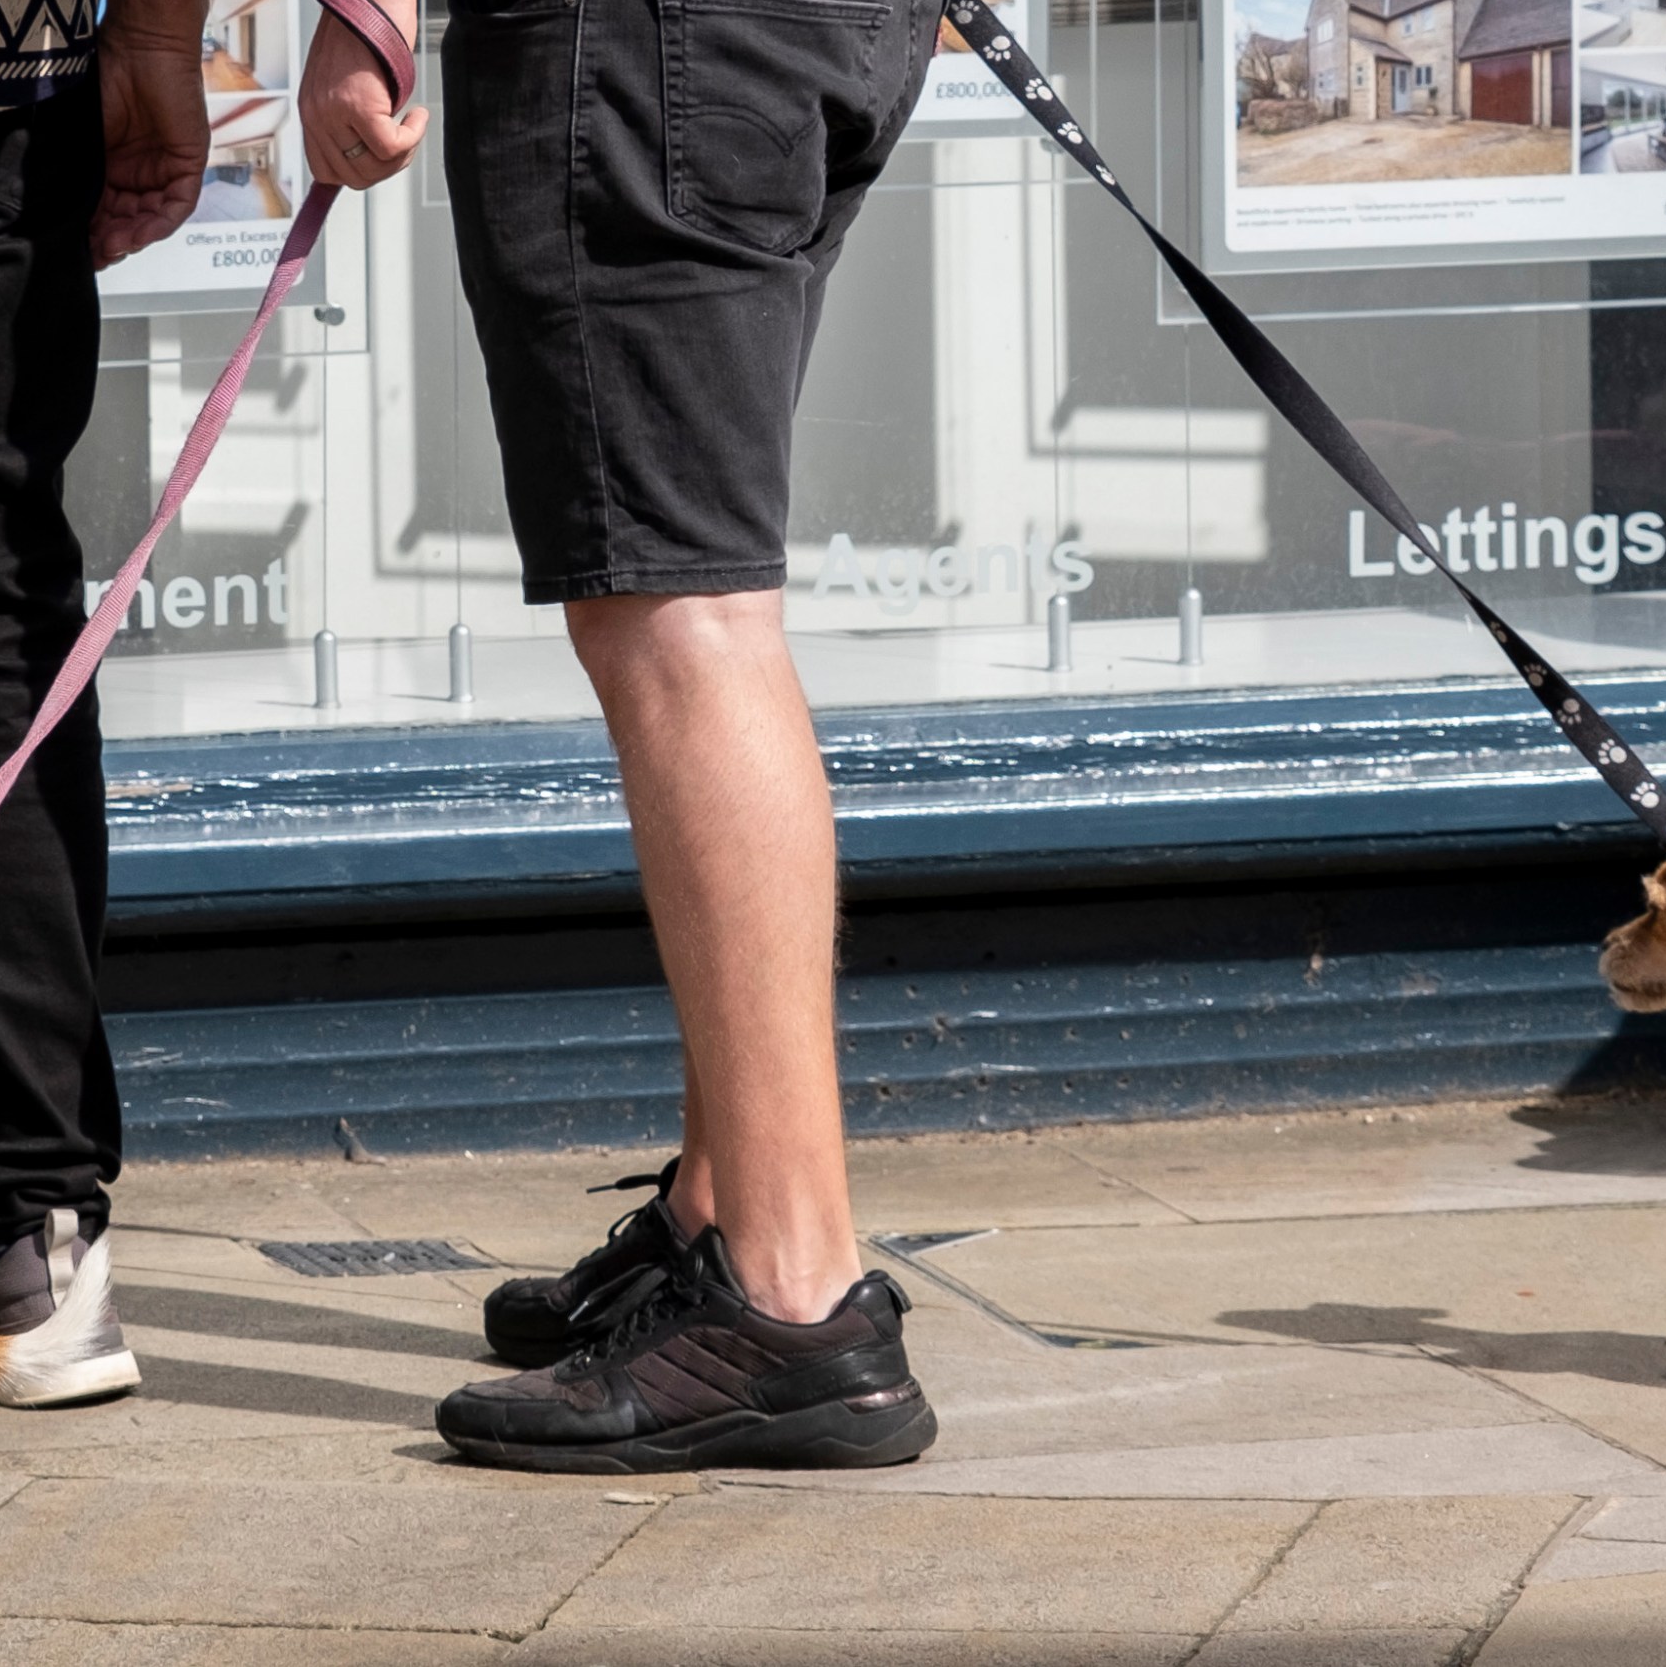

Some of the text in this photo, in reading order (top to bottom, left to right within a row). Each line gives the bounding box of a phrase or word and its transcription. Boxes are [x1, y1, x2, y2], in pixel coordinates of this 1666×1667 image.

[185, 231, 223, 246] Offers
[226, 230, 237, 243] in
[240, 229, 278, 244] Excess
[212, 248, 282, 268] £800,00
[810, 531, 1095, 617] Agents
